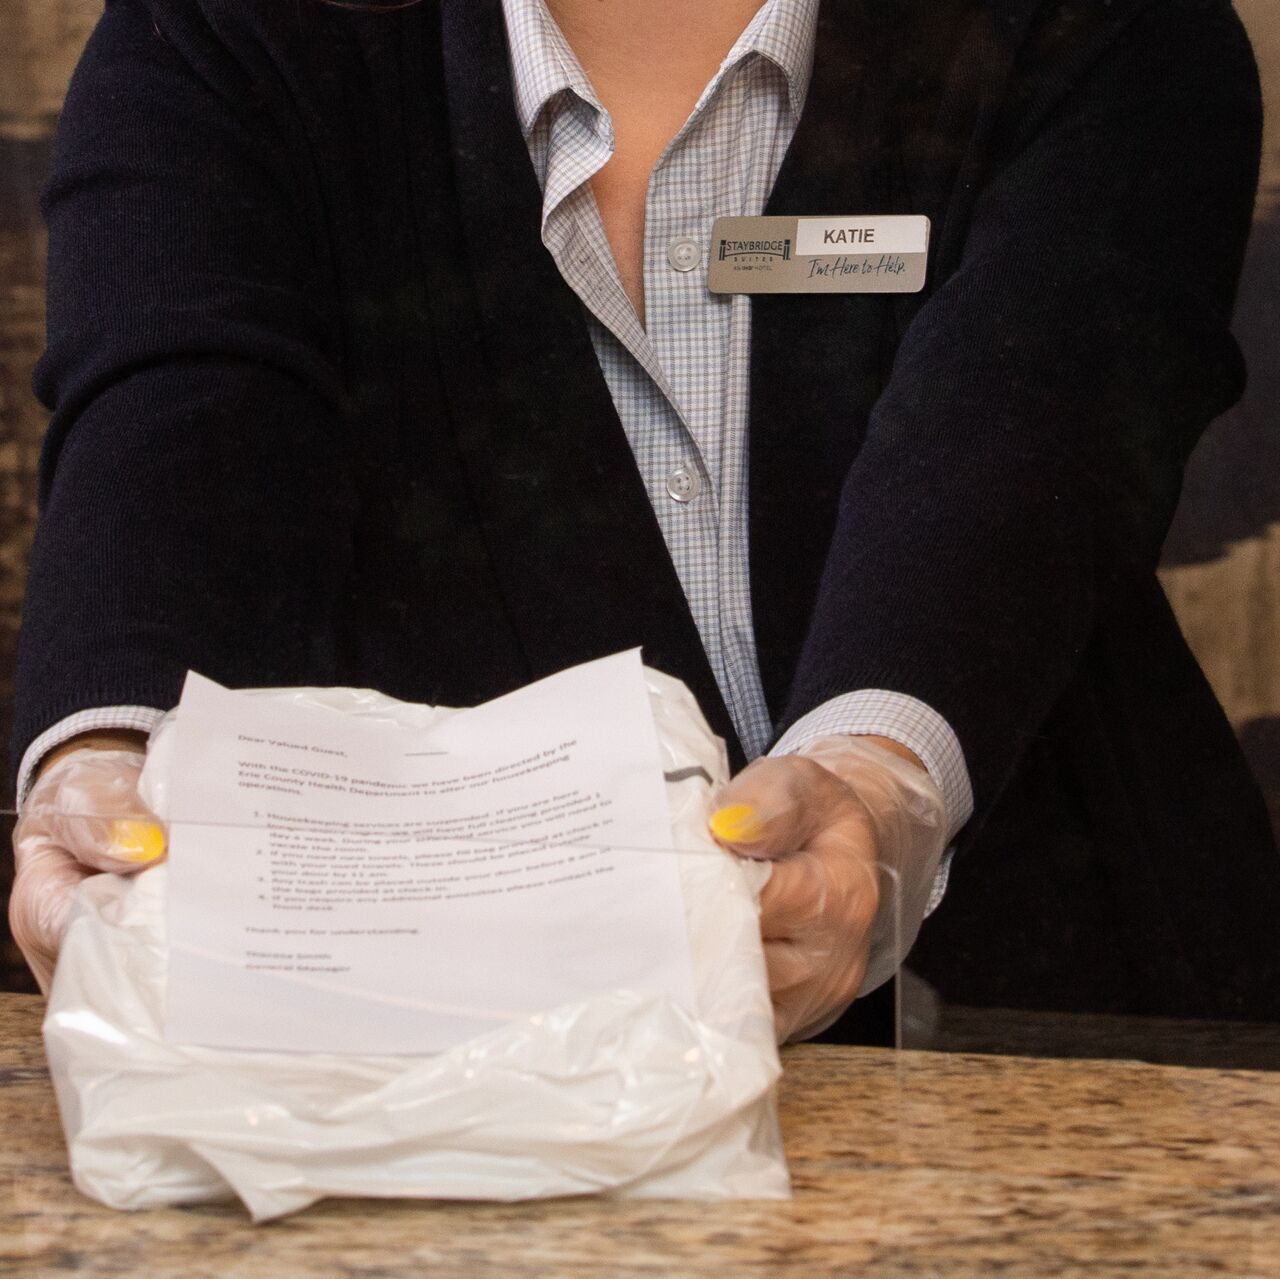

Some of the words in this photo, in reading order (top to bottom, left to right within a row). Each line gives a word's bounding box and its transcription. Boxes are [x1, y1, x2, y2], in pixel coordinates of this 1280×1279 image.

[726, 240, 783, 251] STAYBRIDGE
[824, 229, 874, 243] KATIE
[827, 257, 859, 280] Here
[862, 258, 872, 275] to
[873, 256, 906, 279] Help.
[237, 734, 265, 743] Dear
[267, 738, 309, 751] Valued
[311, 746, 348, 758] Guest,
[238, 760, 266, 770] With
[270, 764, 288, 773] the
[292, 768, 348, 782] COVID-19
[351, 778, 407, 789] pandemic
[431, 778, 459, 786] have
[463, 771, 491, 781] been
[495, 752, 540, 774] directed
[543, 748, 556, 757] by
[559, 739, 577, 750] the
